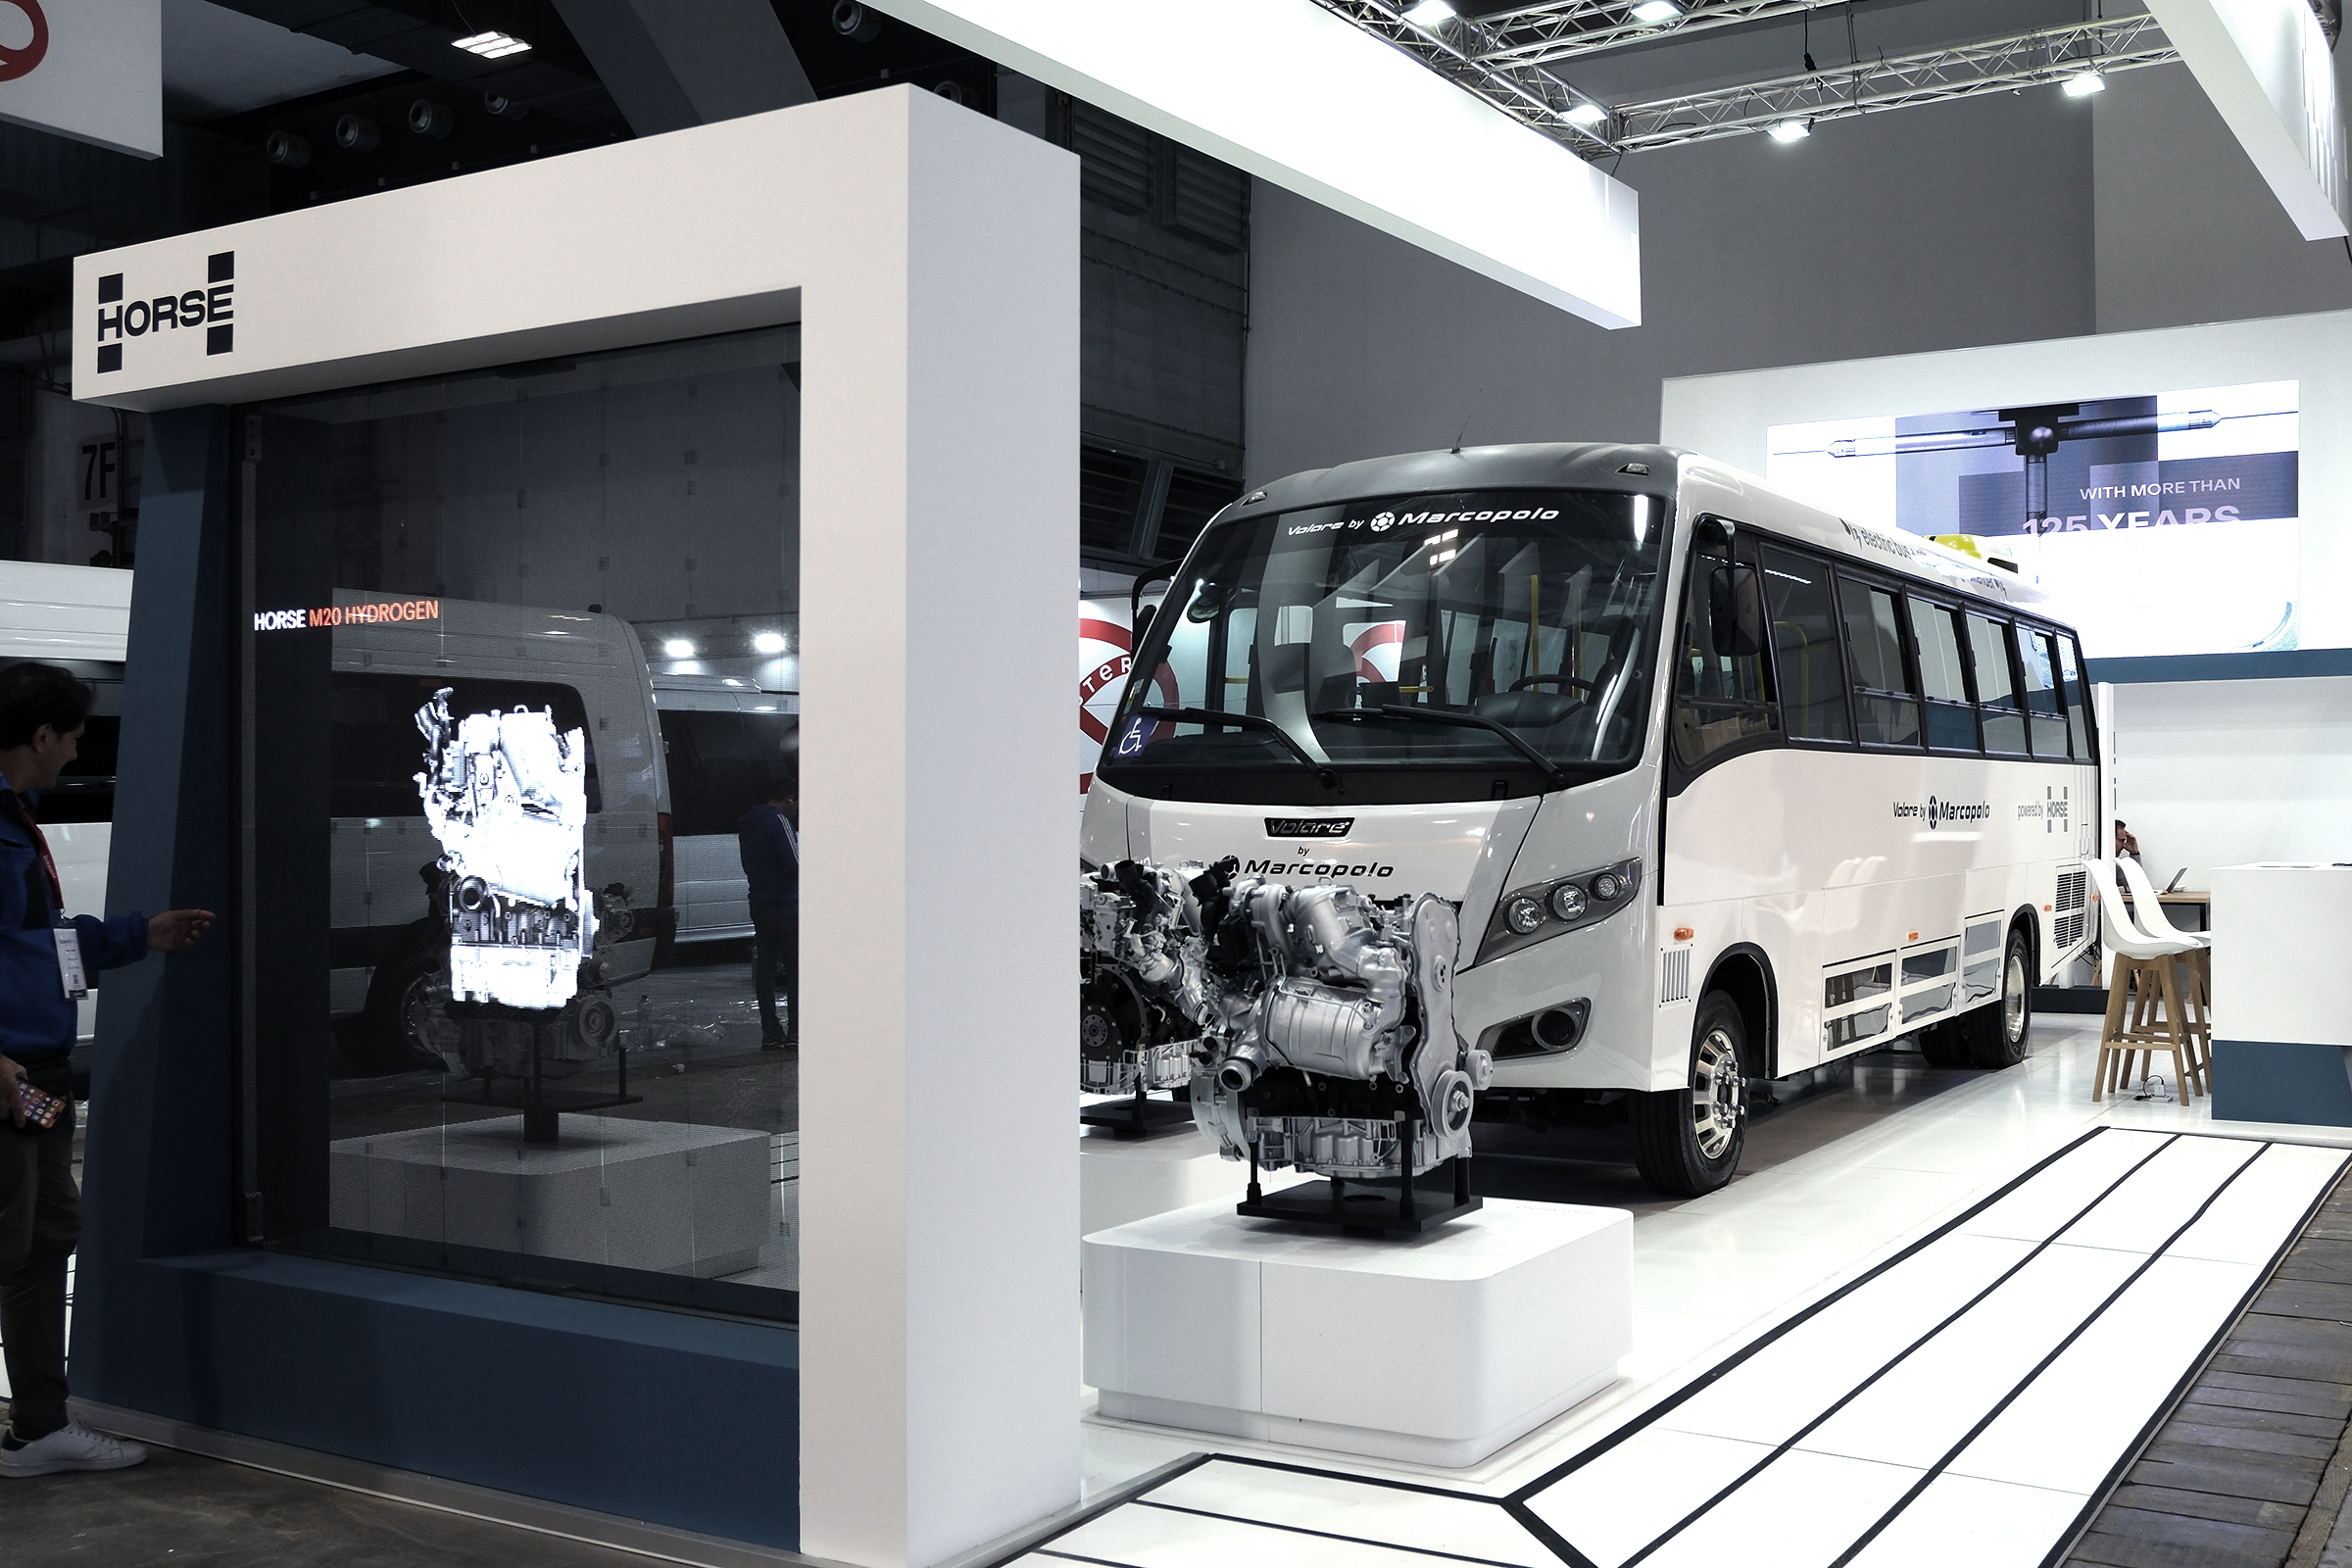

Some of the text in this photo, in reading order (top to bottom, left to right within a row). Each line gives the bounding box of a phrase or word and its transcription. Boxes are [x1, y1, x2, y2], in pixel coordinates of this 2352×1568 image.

[98, 283, 234, 342] HORSE
[82, 441, 116, 501] 7F
[2080, 477, 2240, 500] WITH MORE THAN
[1288, 507, 1560, 536] Volare by Marcopolo
[2022, 505, 2241, 534] 125 YEARS
[254, 600, 439, 631] HORSE M20 HYDROGEN
[1892, 800, 2069, 823] Volare by Marcopolo powered by HORSE
[1270, 819, 1349, 834] Volare
[1297, 846, 1310, 858] by
[1244, 859, 1395, 879] Marcopolo
